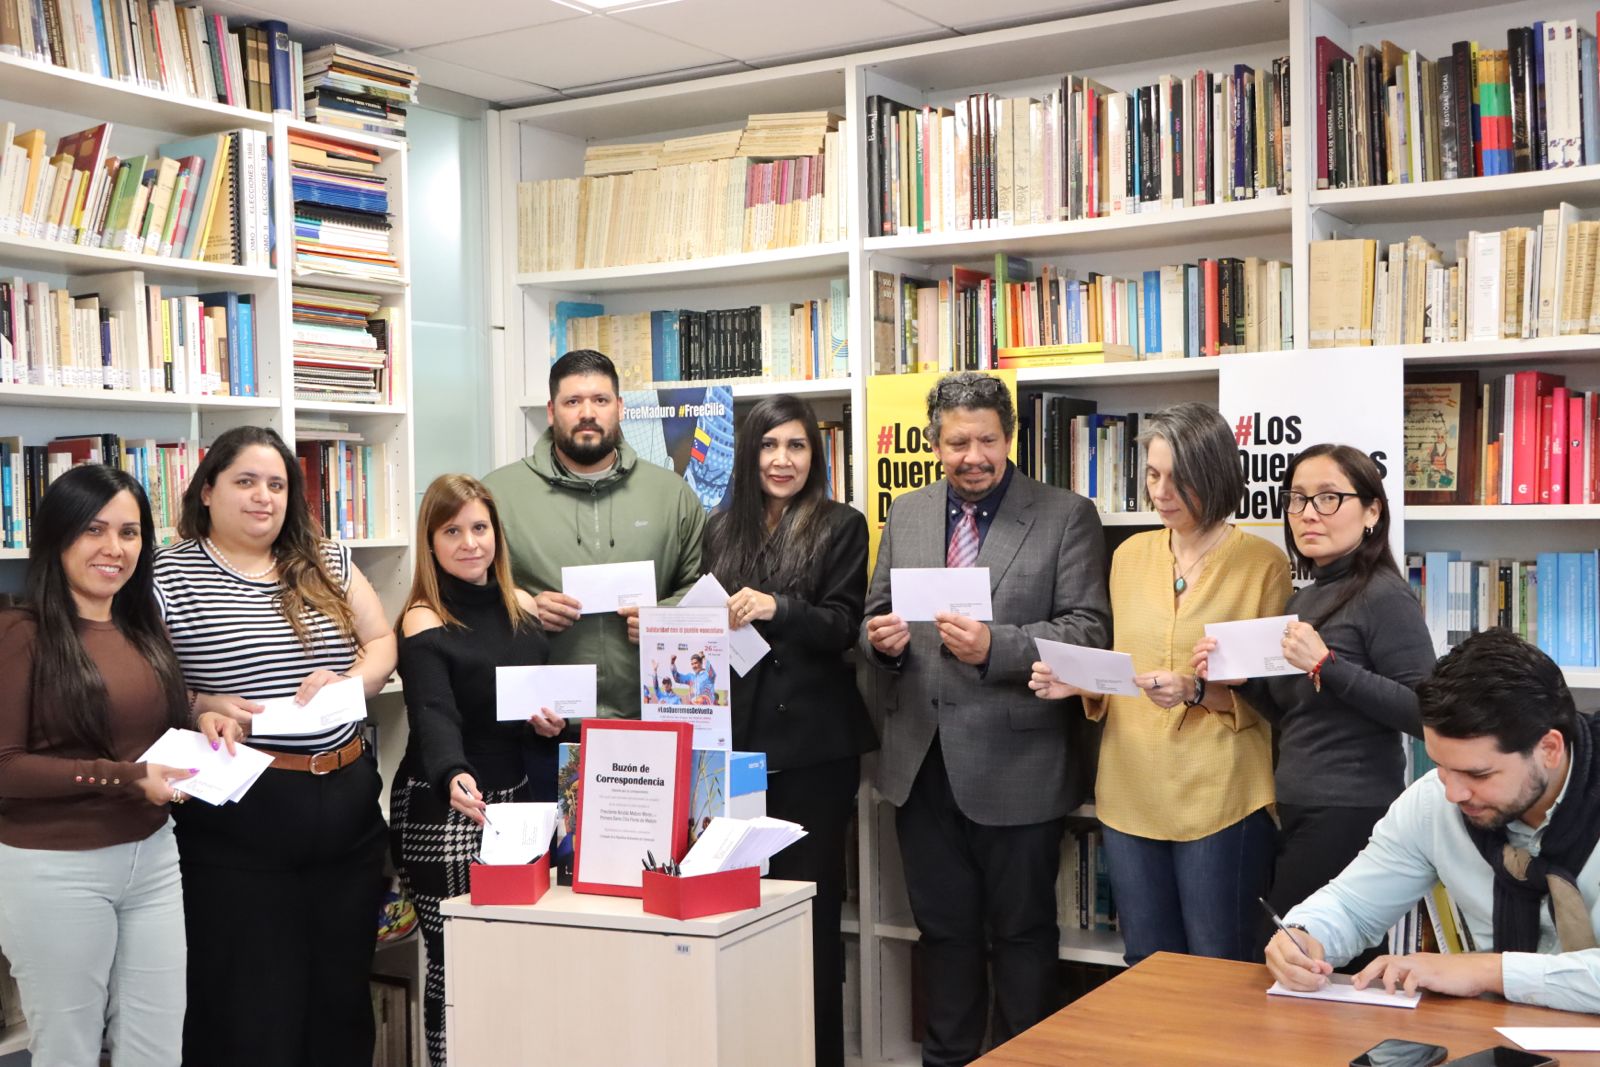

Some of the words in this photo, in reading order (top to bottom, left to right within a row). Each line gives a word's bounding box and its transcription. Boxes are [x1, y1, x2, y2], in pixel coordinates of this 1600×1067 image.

[622, 405, 675, 419] FreeMaduro
[679, 402, 725, 418] #FreeCilia
[1235, 412, 1302, 446] #Los
[658, 706, 713, 715] #LosQueremosDeVuelta
[612, 763, 638, 772] Buzón
[639, 764, 650, 773] de
[596, 774, 665, 787] Correspondencia
